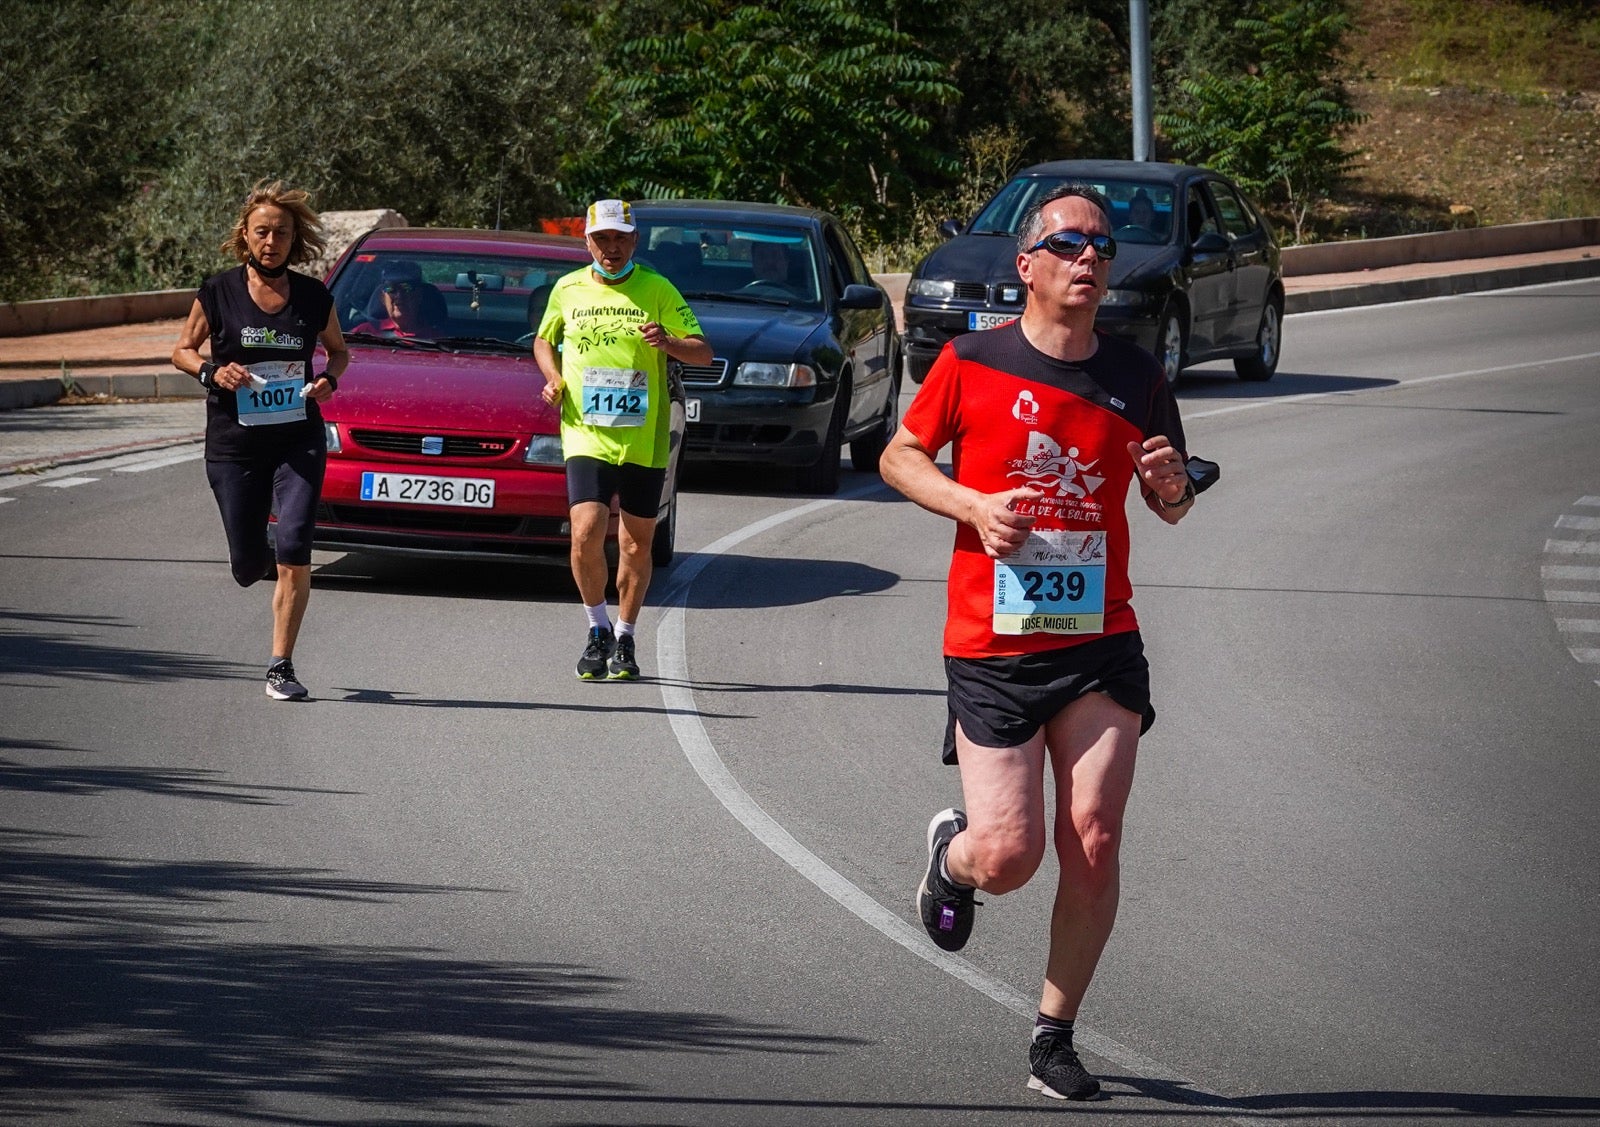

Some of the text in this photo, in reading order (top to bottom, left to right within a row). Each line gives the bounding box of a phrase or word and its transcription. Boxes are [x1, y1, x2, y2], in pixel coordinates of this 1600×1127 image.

[572, 305, 646, 320] Cantarranas
[249, 387, 295, 408] 1007
[591, 393, 641, 414] 1142
[376, 477, 492, 504] A 2736 DG
[1037, 505, 1053, 516] DE
[1054, 508, 1103, 523] ALBOLOTE
[998, 580, 1006, 606] MASTER
[1023, 571, 1085, 602] 239
[1020, 617, 1079, 630] JOSE MIGUEL
